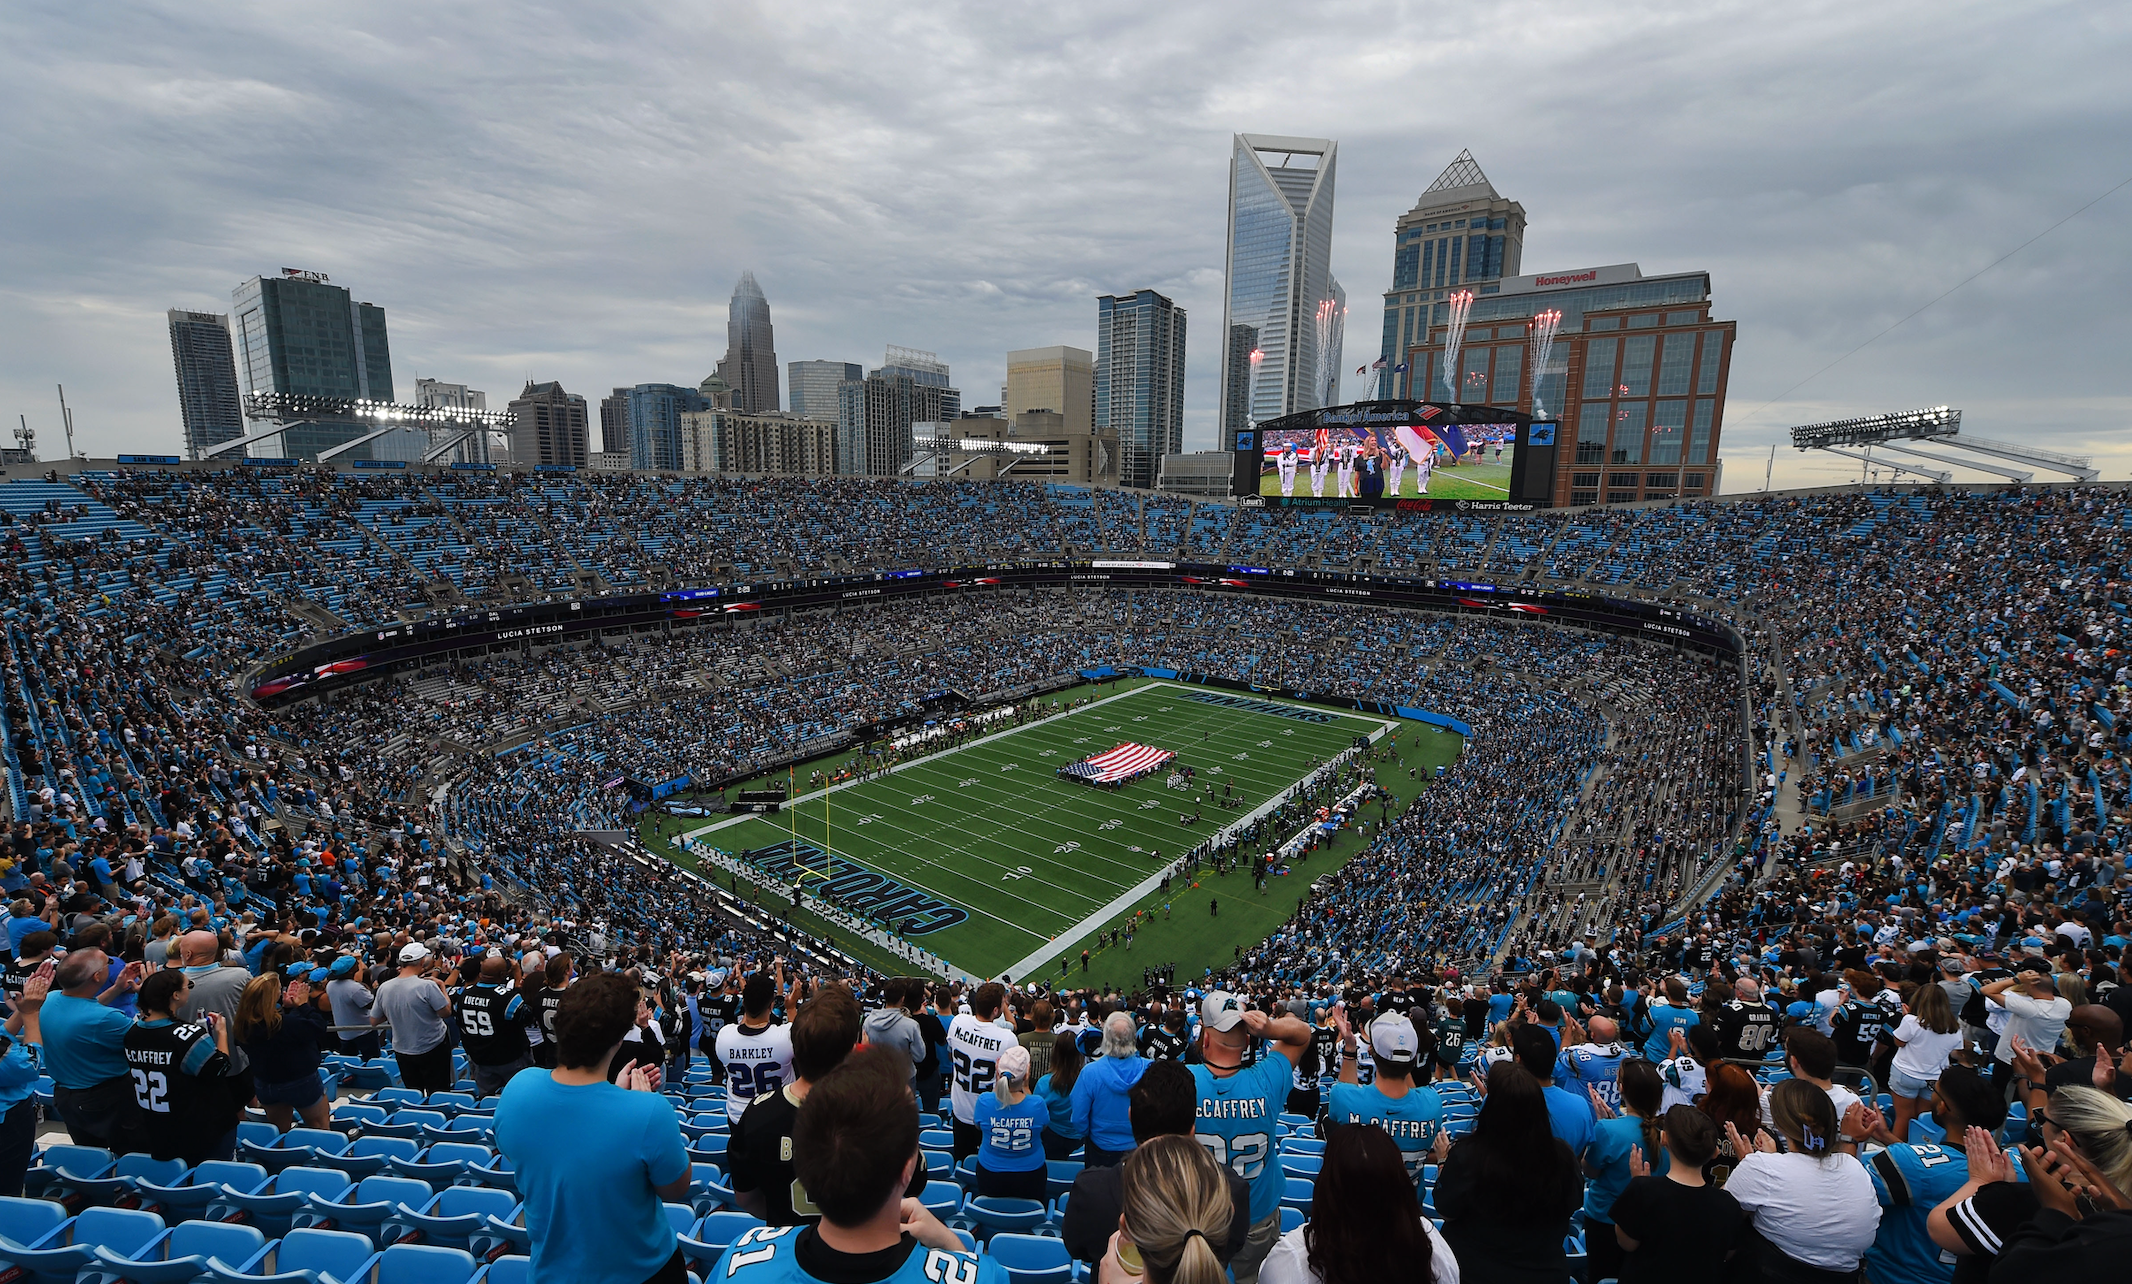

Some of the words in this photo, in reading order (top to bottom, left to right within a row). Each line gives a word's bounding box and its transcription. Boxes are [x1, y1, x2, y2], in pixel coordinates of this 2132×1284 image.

[304, 270, 330, 281] FNB
[1535, 271, 1597, 286] Honeywell
[1323, 411, 1350, 423] Bank
[1350, 410, 1362, 423] of
[1363, 410, 1410, 422] America
[1291, 498, 1321, 507] Atrium
[1321, 498, 1350, 507] Health
[1396, 499, 1434, 511] Coca-Cola
[1471, 502, 1500, 510] Harris
[1502, 502, 1533, 511] Teeter
[1344, 588, 1370, 596] STETSON
[497, 630, 523, 639] LUCIA
[525, 625, 563, 635] STETSON
[1644, 622, 1661, 631] LUCIA
[1663, 627, 1690, 637] STETSON
[911, 794, 935, 805] 20
[1142, 799, 1161, 810] 40
[858, 813, 884, 825] 10
[1102, 818, 1124, 830] 30
[1056, 840, 1081, 854] 20
[1005, 865, 1033, 881] 10
[750, 839, 970, 937] CAROLINA
[464, 995, 491, 1008] KUECHLY
[542, 997, 559, 1008] BREE
[701, 1007, 722, 1016] KUECHLY
[1749, 1013, 1771, 1022] GRAHAM
[462, 1009, 494, 1036] 59
[700, 1017, 725, 1039] 59
[173, 1022, 202, 1041] 22
[954, 1026, 1002, 1052] McCAFFREY
[1738, 1024, 1773, 1051] 80
[1857, 1023, 1881, 1042] 59
[1446, 1032, 1461, 1047] 26
[729, 1047, 774, 1060] BARKLEY
[953, 1048, 996, 1093] 22
[1681, 1059, 1694, 1072] 99
[726, 1061, 781, 1099] 26
[130, 1067, 171, 1113] 22
[1195, 1097, 1267, 1119] cCAFFREY
[990, 1116, 1034, 1129] McCAFFREY
[1349, 1112, 1436, 1139] MAFFREY
[990, 1127, 1032, 1151] 22
[1911, 1142, 1951, 1170] 21
[726, 1226, 794, 1278] 21
[923, 1250, 980, 1284] 2
